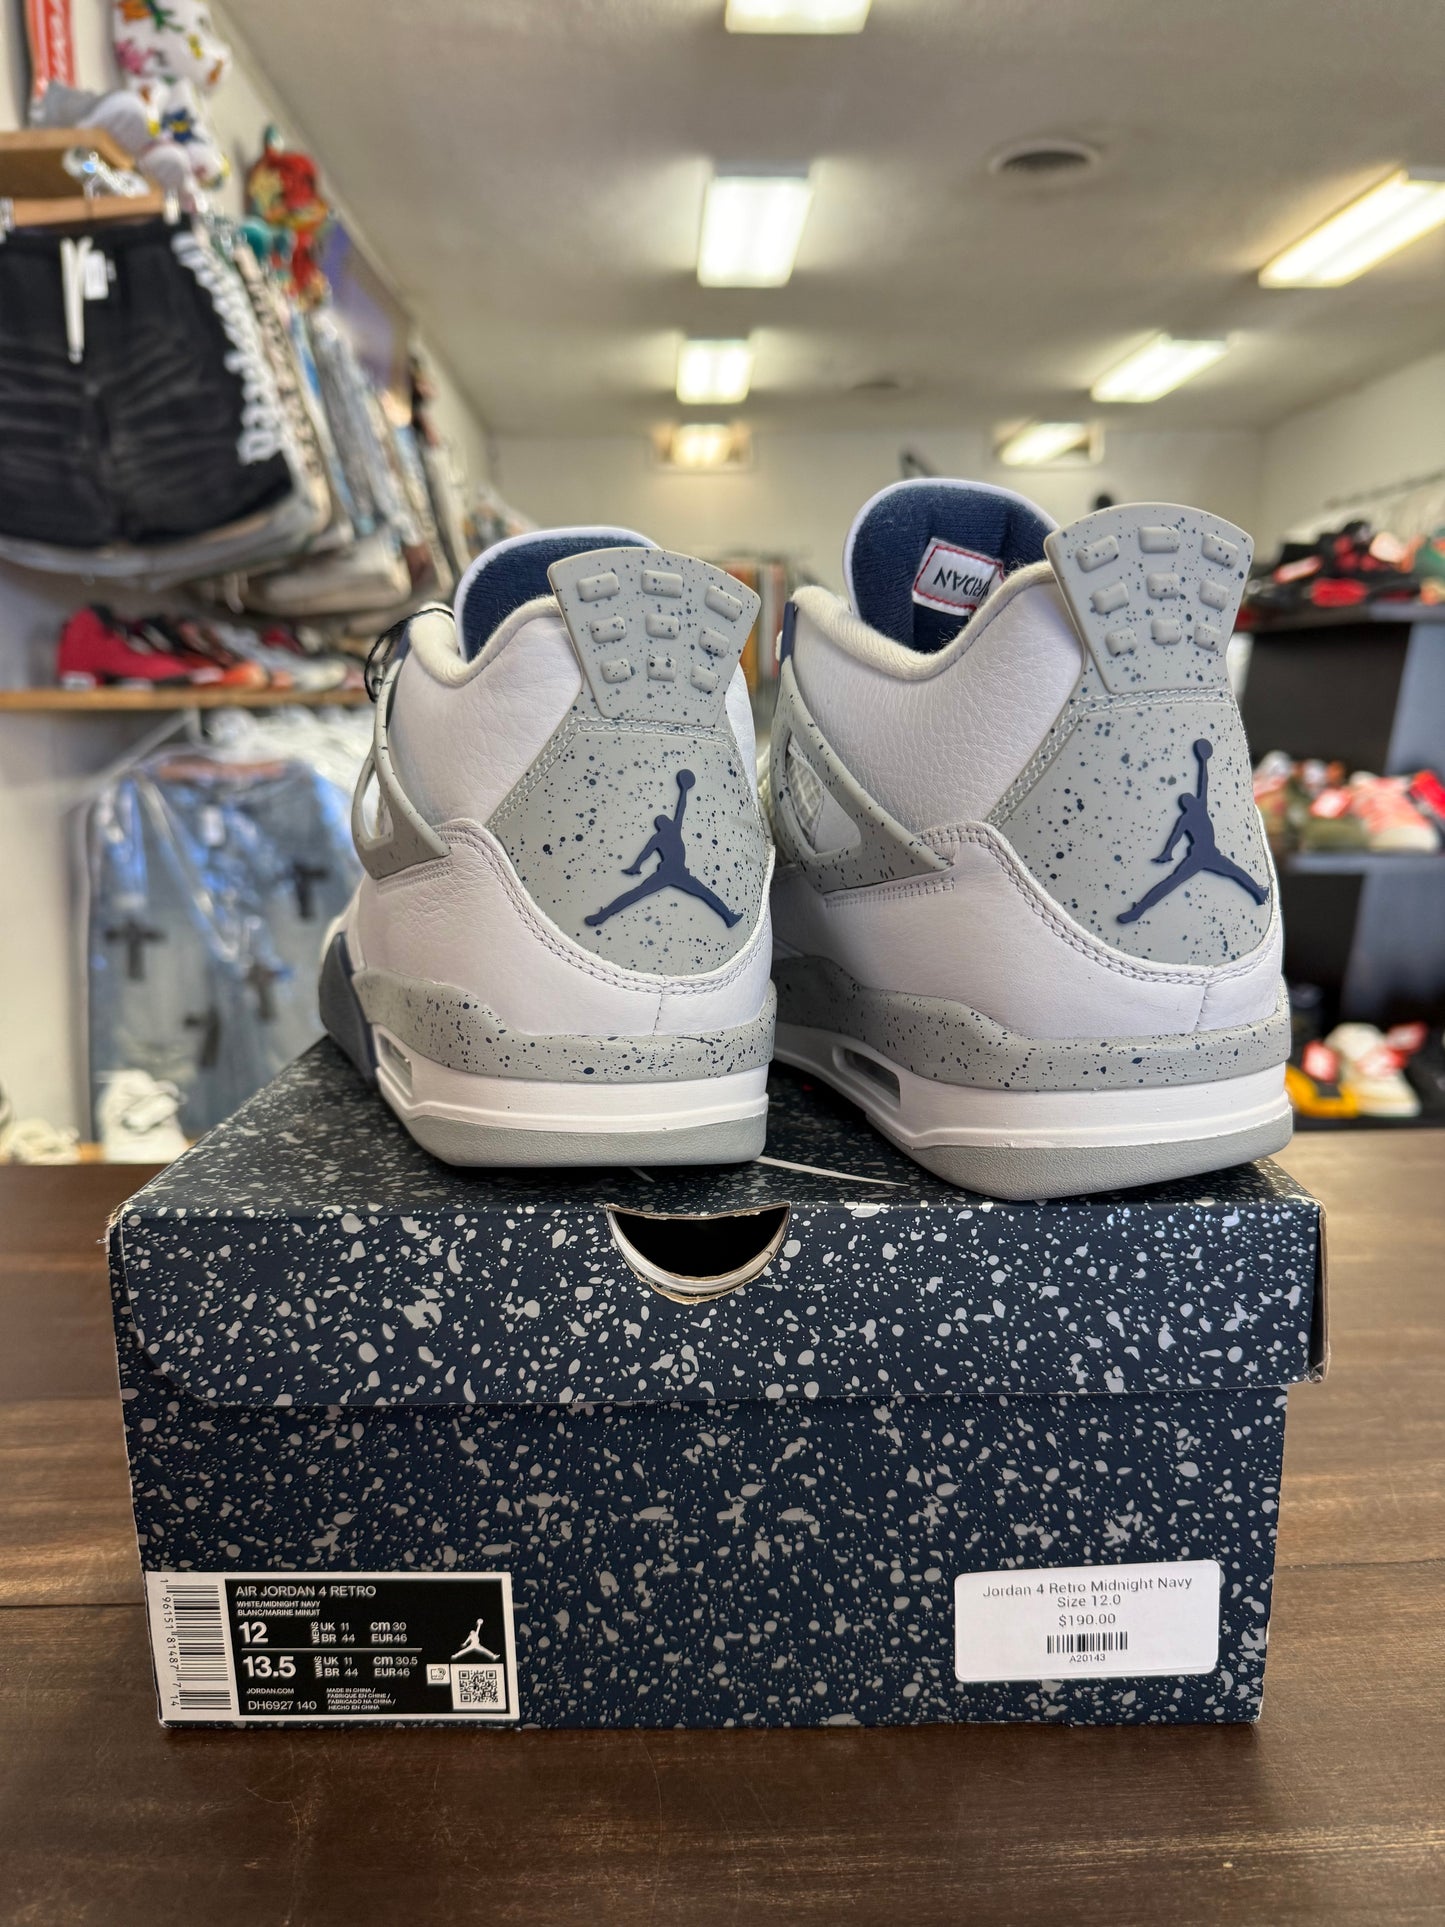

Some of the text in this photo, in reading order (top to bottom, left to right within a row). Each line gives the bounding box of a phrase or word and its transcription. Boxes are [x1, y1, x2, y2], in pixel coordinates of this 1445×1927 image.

[932, 566, 990, 598] RDAN
[236, 1585, 377, 1597] AIR JORDAN 4 RETRO
[983, 1577, 1192, 1597] Jordan 4 Retro Midnight Navy
[236, 1601, 299, 1609] WHITE/MIDNIGHT
[1057, 1594, 1121, 1608] Size 12.0
[162, 1596, 174, 1629] 96151
[237, 1609, 294, 1617] BLANC/MARINE
[1058, 1613, 1116, 1627] $190.00
[320, 1622, 350, 1631] UK 11
[370, 1622, 407, 1631] cm 30
[239, 1621, 269, 1644] 12
[310, 1621, 320, 1644] MENS
[320, 1633, 356, 1643] BR 44
[371, 1633, 408, 1643] EUR 46
[166, 1637, 179, 1670] 81487
[1069, 1653, 1106, 1663] A20143
[323, 1656, 353, 1666] UK 11
[373, 1656, 418, 1666] cm 30.5
[243, 1655, 297, 1678] 13.5
[324, 1667, 359, 1678] BR 44
[374, 1667, 411, 1677] EUR 46
[246, 1687, 294, 1695] JORDAN.COM
[170, 1695, 179, 1706] 14
[248, 1701, 317, 1710] DH6927 140
